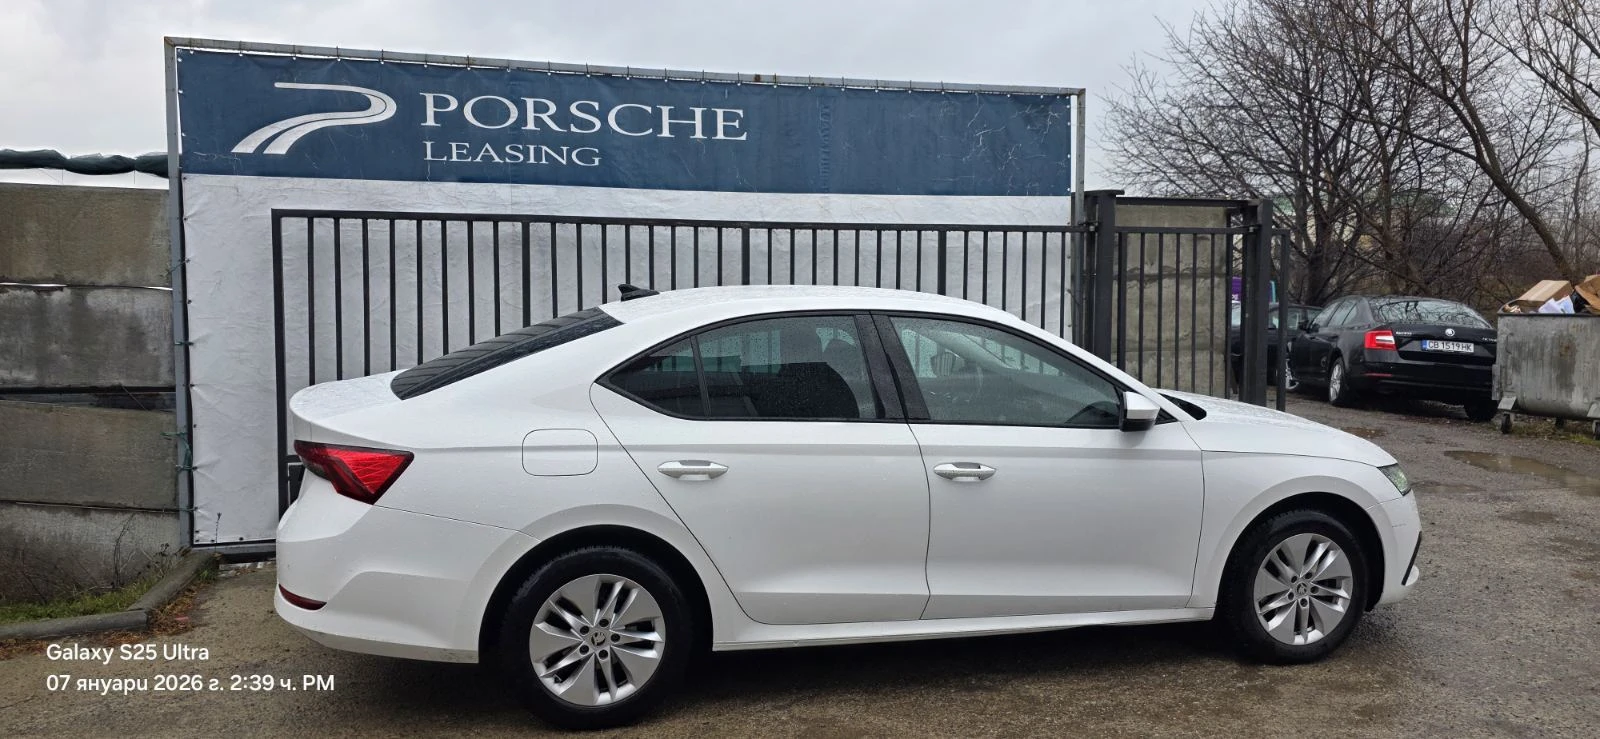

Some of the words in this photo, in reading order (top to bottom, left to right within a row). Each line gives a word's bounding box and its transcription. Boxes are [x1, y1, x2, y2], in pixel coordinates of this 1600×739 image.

[419, 92, 748, 141] PORSCHE
[423, 141, 601, 166] LEASING
[1428, 341, 1439, 349] CB
[1441, 342, 1461, 351] 1519
[1461, 343, 1472, 351] HK
